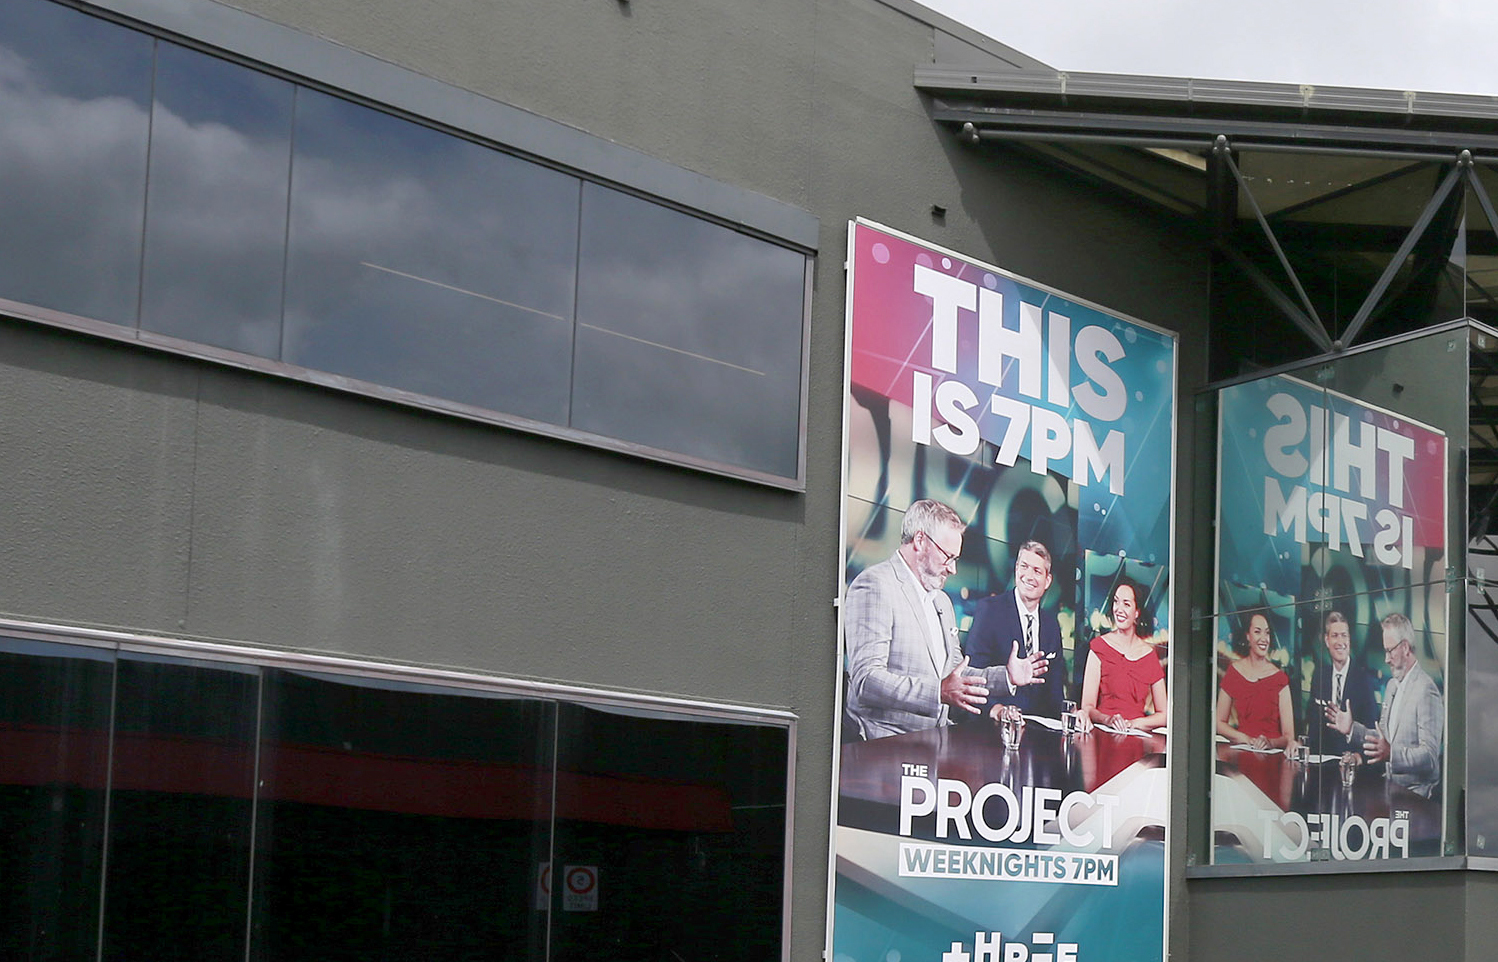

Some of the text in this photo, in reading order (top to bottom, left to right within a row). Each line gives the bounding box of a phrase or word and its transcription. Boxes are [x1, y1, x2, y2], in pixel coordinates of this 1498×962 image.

[914, 263, 1128, 422] THIS
[912, 370, 1125, 496] IS 7PM
[902, 763, 929, 777] THE
[899, 775, 1120, 849] PROJECT
[904, 848, 1114, 881] WEEKNIGHTS 7PM
